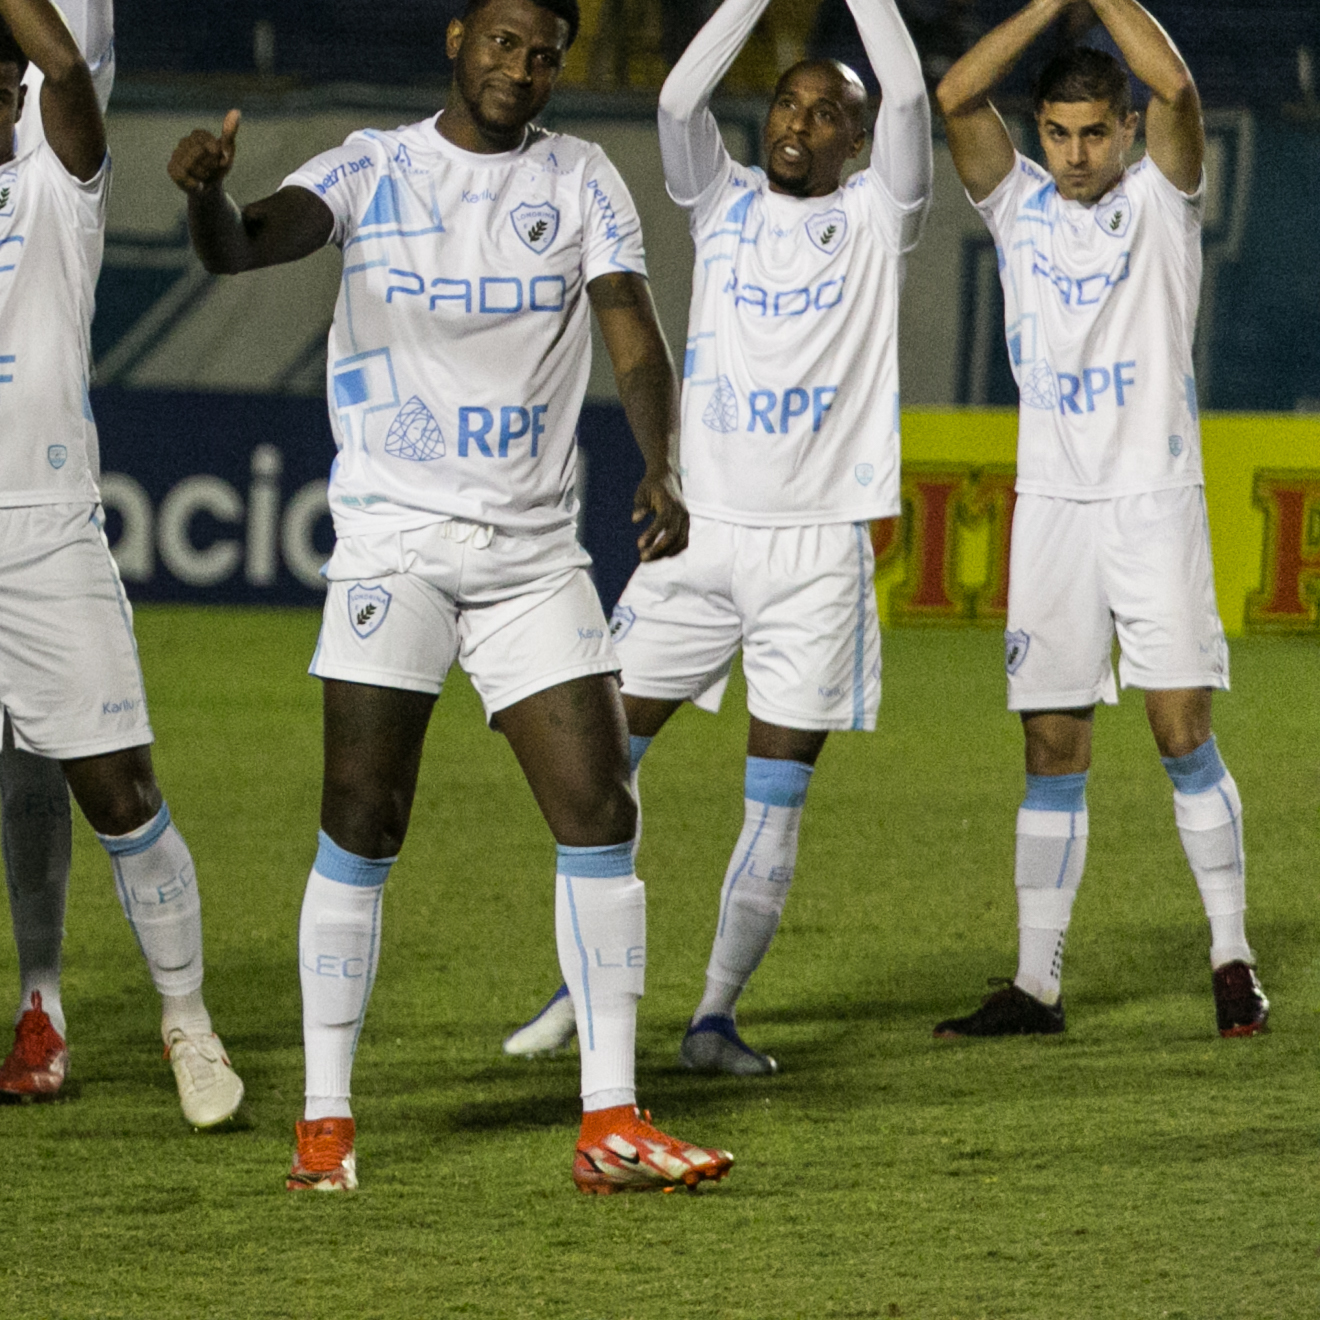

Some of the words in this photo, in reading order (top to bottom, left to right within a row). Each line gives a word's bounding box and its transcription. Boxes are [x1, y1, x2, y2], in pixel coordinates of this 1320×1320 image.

[385, 267, 567, 315] PADO
[746, 385, 839, 435] RPF
[1054, 360, 1137, 416] RPF
[457, 403, 549, 458] RPF
[302, 949, 364, 979] LEC
[594, 945, 644, 969] LE
